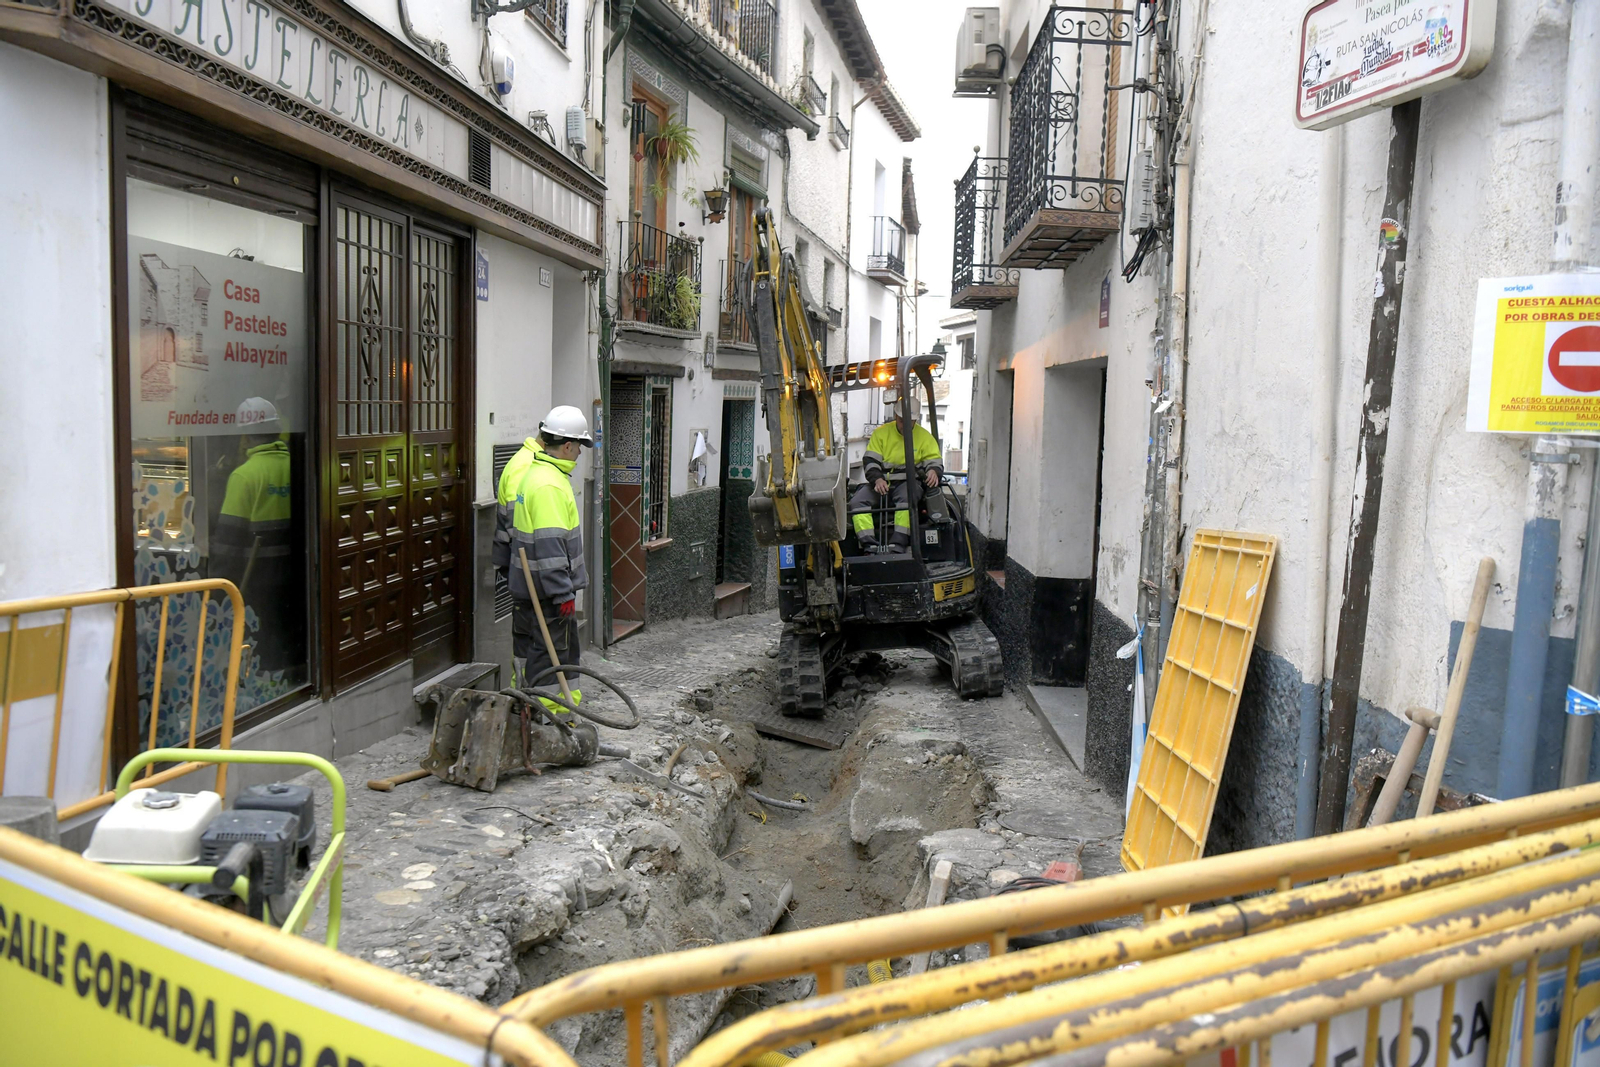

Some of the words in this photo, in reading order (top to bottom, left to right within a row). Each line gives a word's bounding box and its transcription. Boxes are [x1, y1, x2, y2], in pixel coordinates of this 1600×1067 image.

[1365, 3, 1391, 24] Pasea
[1336, 40, 1358, 58] RUTA
[1360, 29, 1379, 48] SAN
[1381, 9, 1423, 38] NICOLÁS
[135, 0, 410, 148] ASTELERIA
[224, 279, 260, 304] Casa
[1508, 298, 1555, 307] CUESTA
[1559, 297, 1600, 306] ALHAC
[224, 310, 287, 337] Pasteles
[1505, 313, 1528, 321] POR
[1532, 312, 1574, 321] OBRAS
[1579, 312, 1600, 321] DES
[224, 342, 287, 369] Albayzín
[168, 410, 219, 425] Fundada
[222, 413, 236, 424] en
[239, 410, 265, 425] 1928
[1548, 404, 1591, 412] QUEDARÁN
[73, 941, 217, 1061] CORTADA
[229, 1008, 304, 1067] POR
